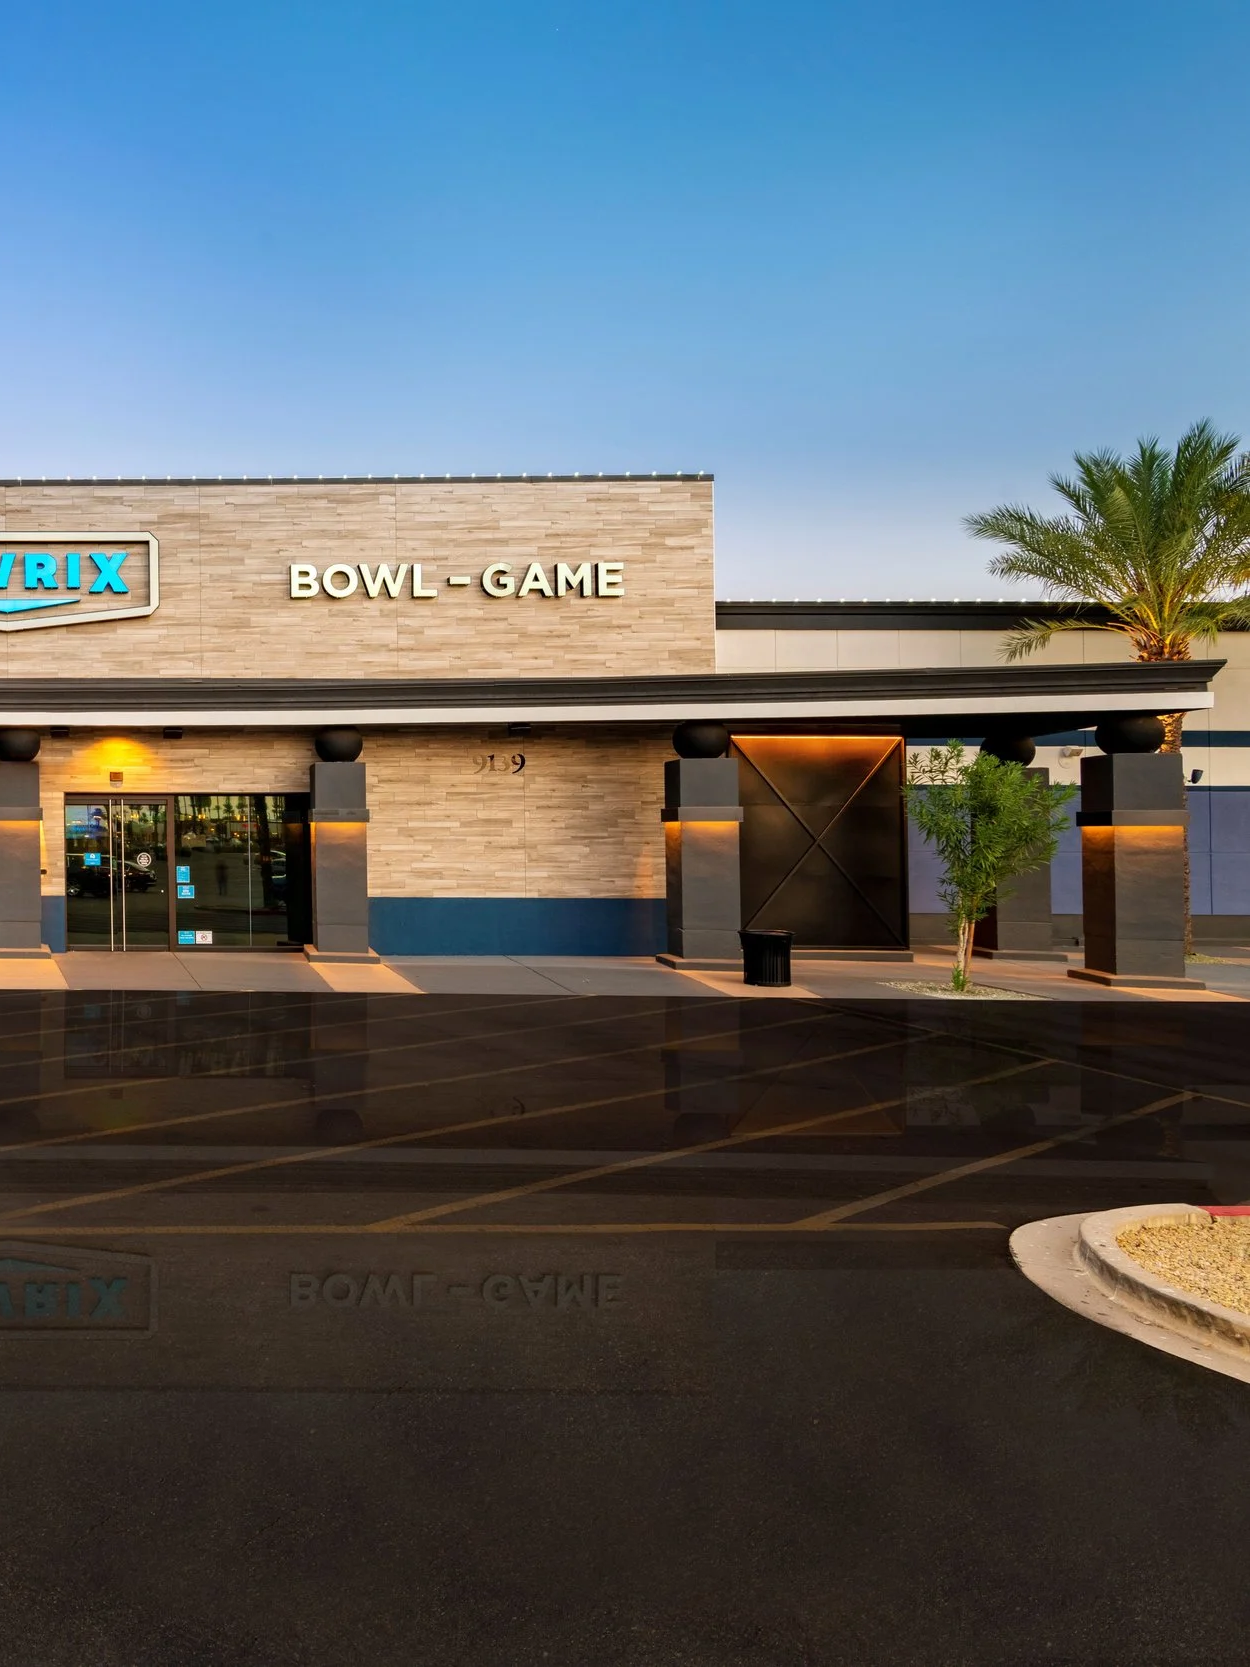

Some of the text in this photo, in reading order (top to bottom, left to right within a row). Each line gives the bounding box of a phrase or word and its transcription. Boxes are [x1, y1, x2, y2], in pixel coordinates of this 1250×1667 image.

[289, 563, 438, 599] BOWL
[481, 562, 625, 599] GAME
[472, 753, 526, 775] 9139
